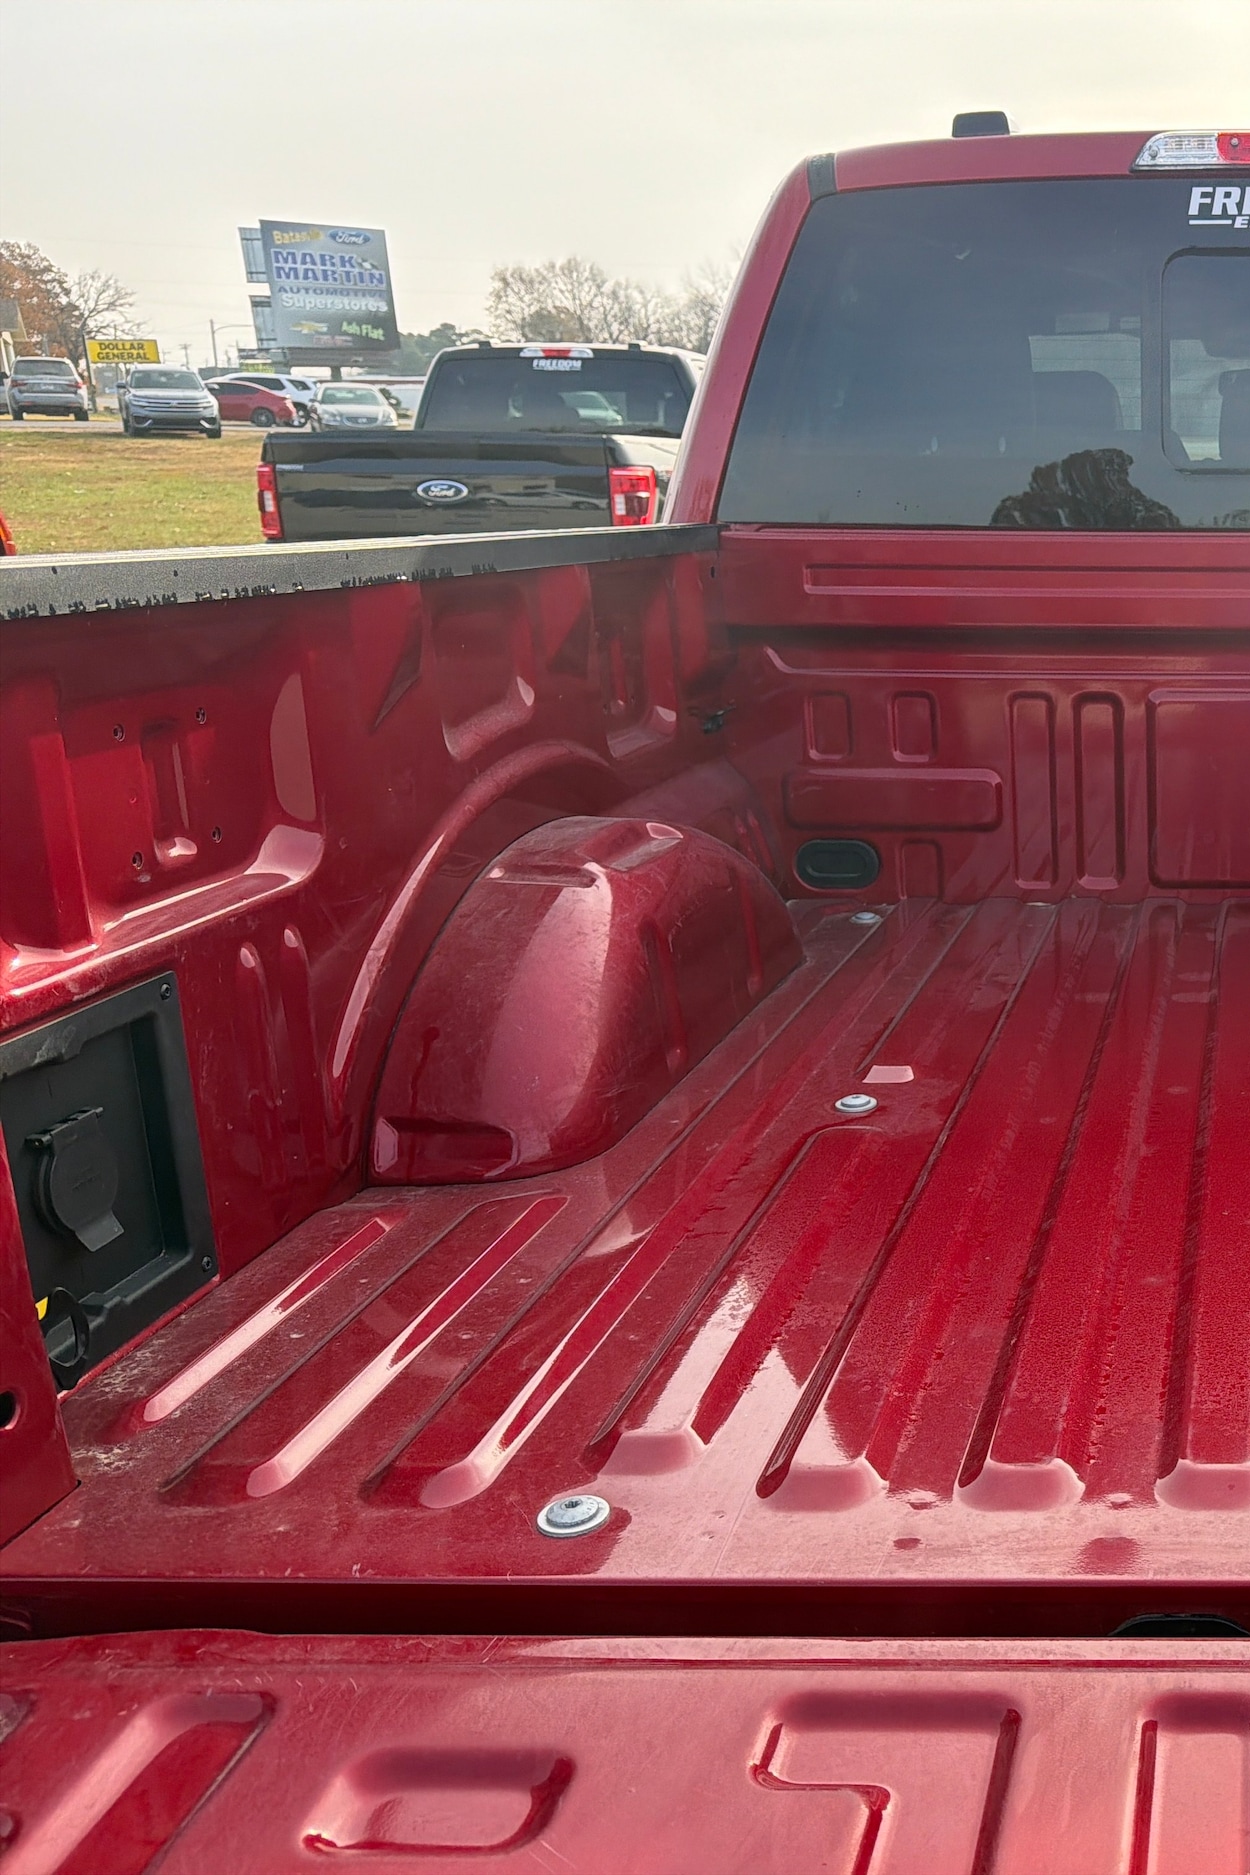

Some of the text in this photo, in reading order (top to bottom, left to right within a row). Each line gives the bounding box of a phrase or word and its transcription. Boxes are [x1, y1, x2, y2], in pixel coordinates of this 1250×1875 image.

[271, 249, 356, 269] MARK
[274, 266, 385, 287] MARTIN
[278, 286, 386, 298] AUTOMOTIVE
[281, 294, 389, 312] Superstores
[341, 321, 386, 341] Ash Flat
[98, 342, 145, 351] DOLLAR
[97, 352, 150, 360] GENERAL
[532, 359, 582, 368] FREEDOM
[428, 485, 456, 497] Ford
